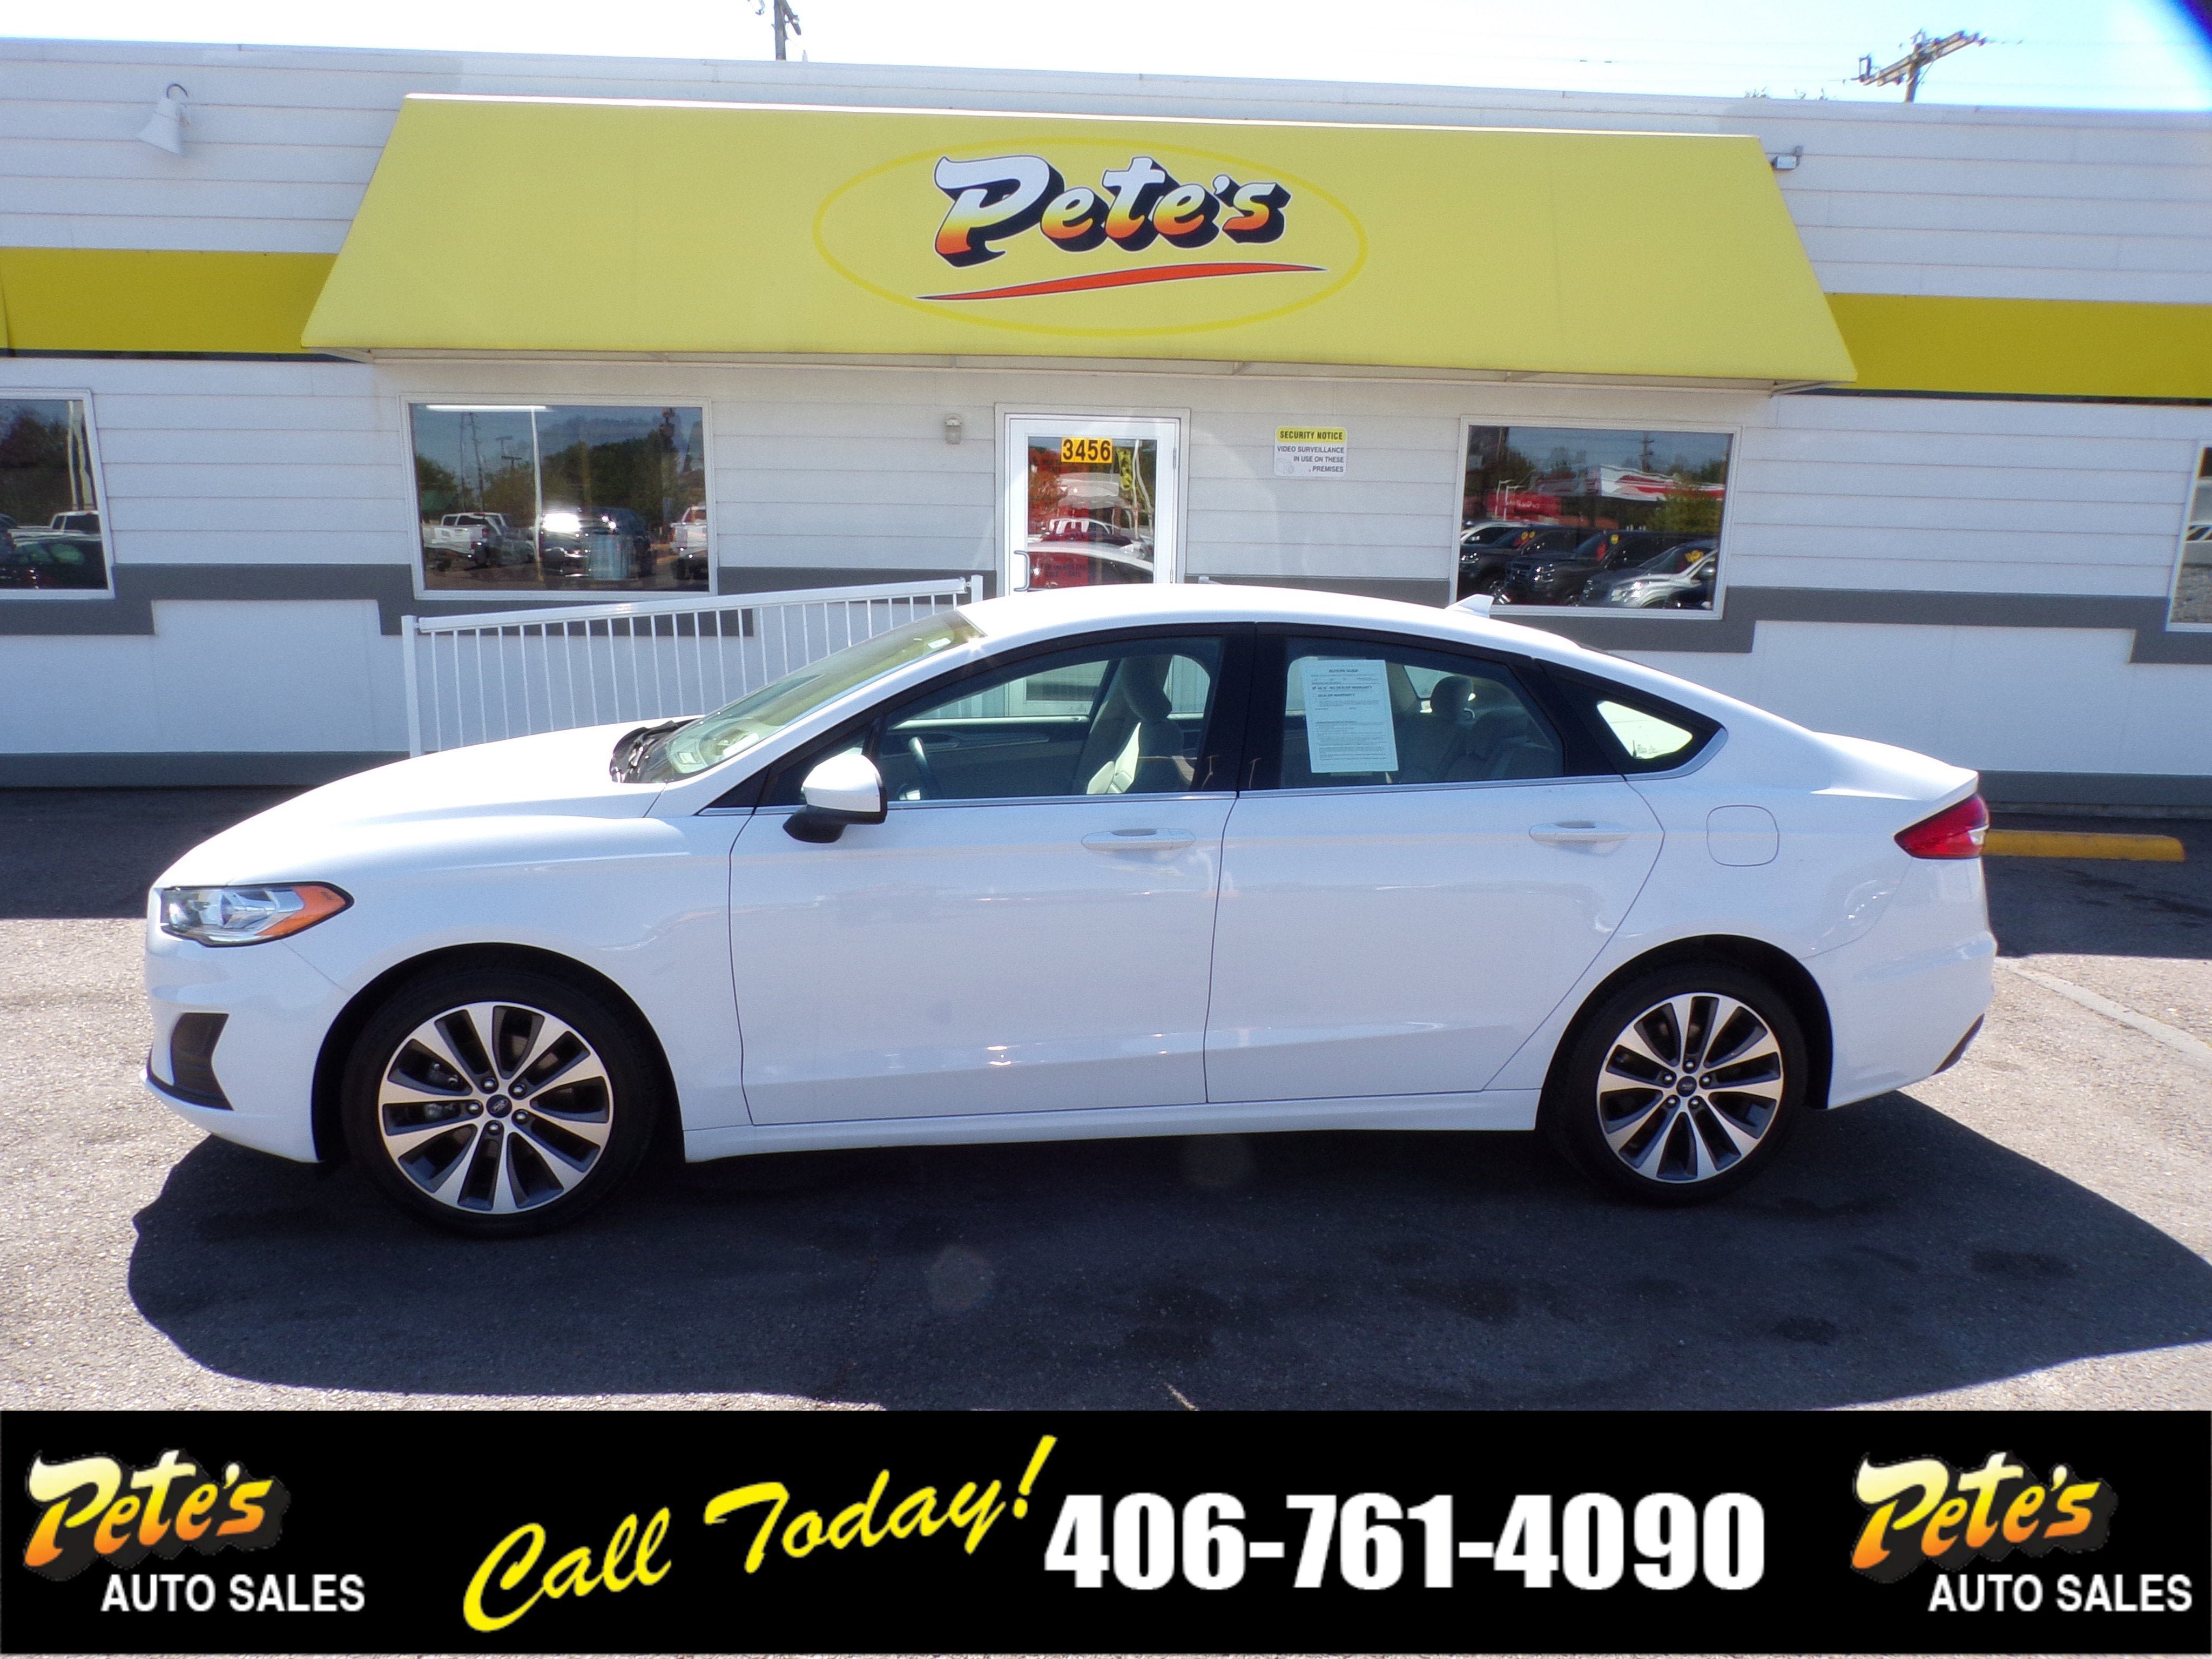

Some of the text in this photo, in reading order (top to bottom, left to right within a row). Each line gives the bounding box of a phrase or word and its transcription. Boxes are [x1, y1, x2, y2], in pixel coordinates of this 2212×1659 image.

[934, 154, 1292, 268] Pete's
[1280, 431, 1343, 440] SECURITY NOTICE
[1062, 439, 1111, 461] 3456
